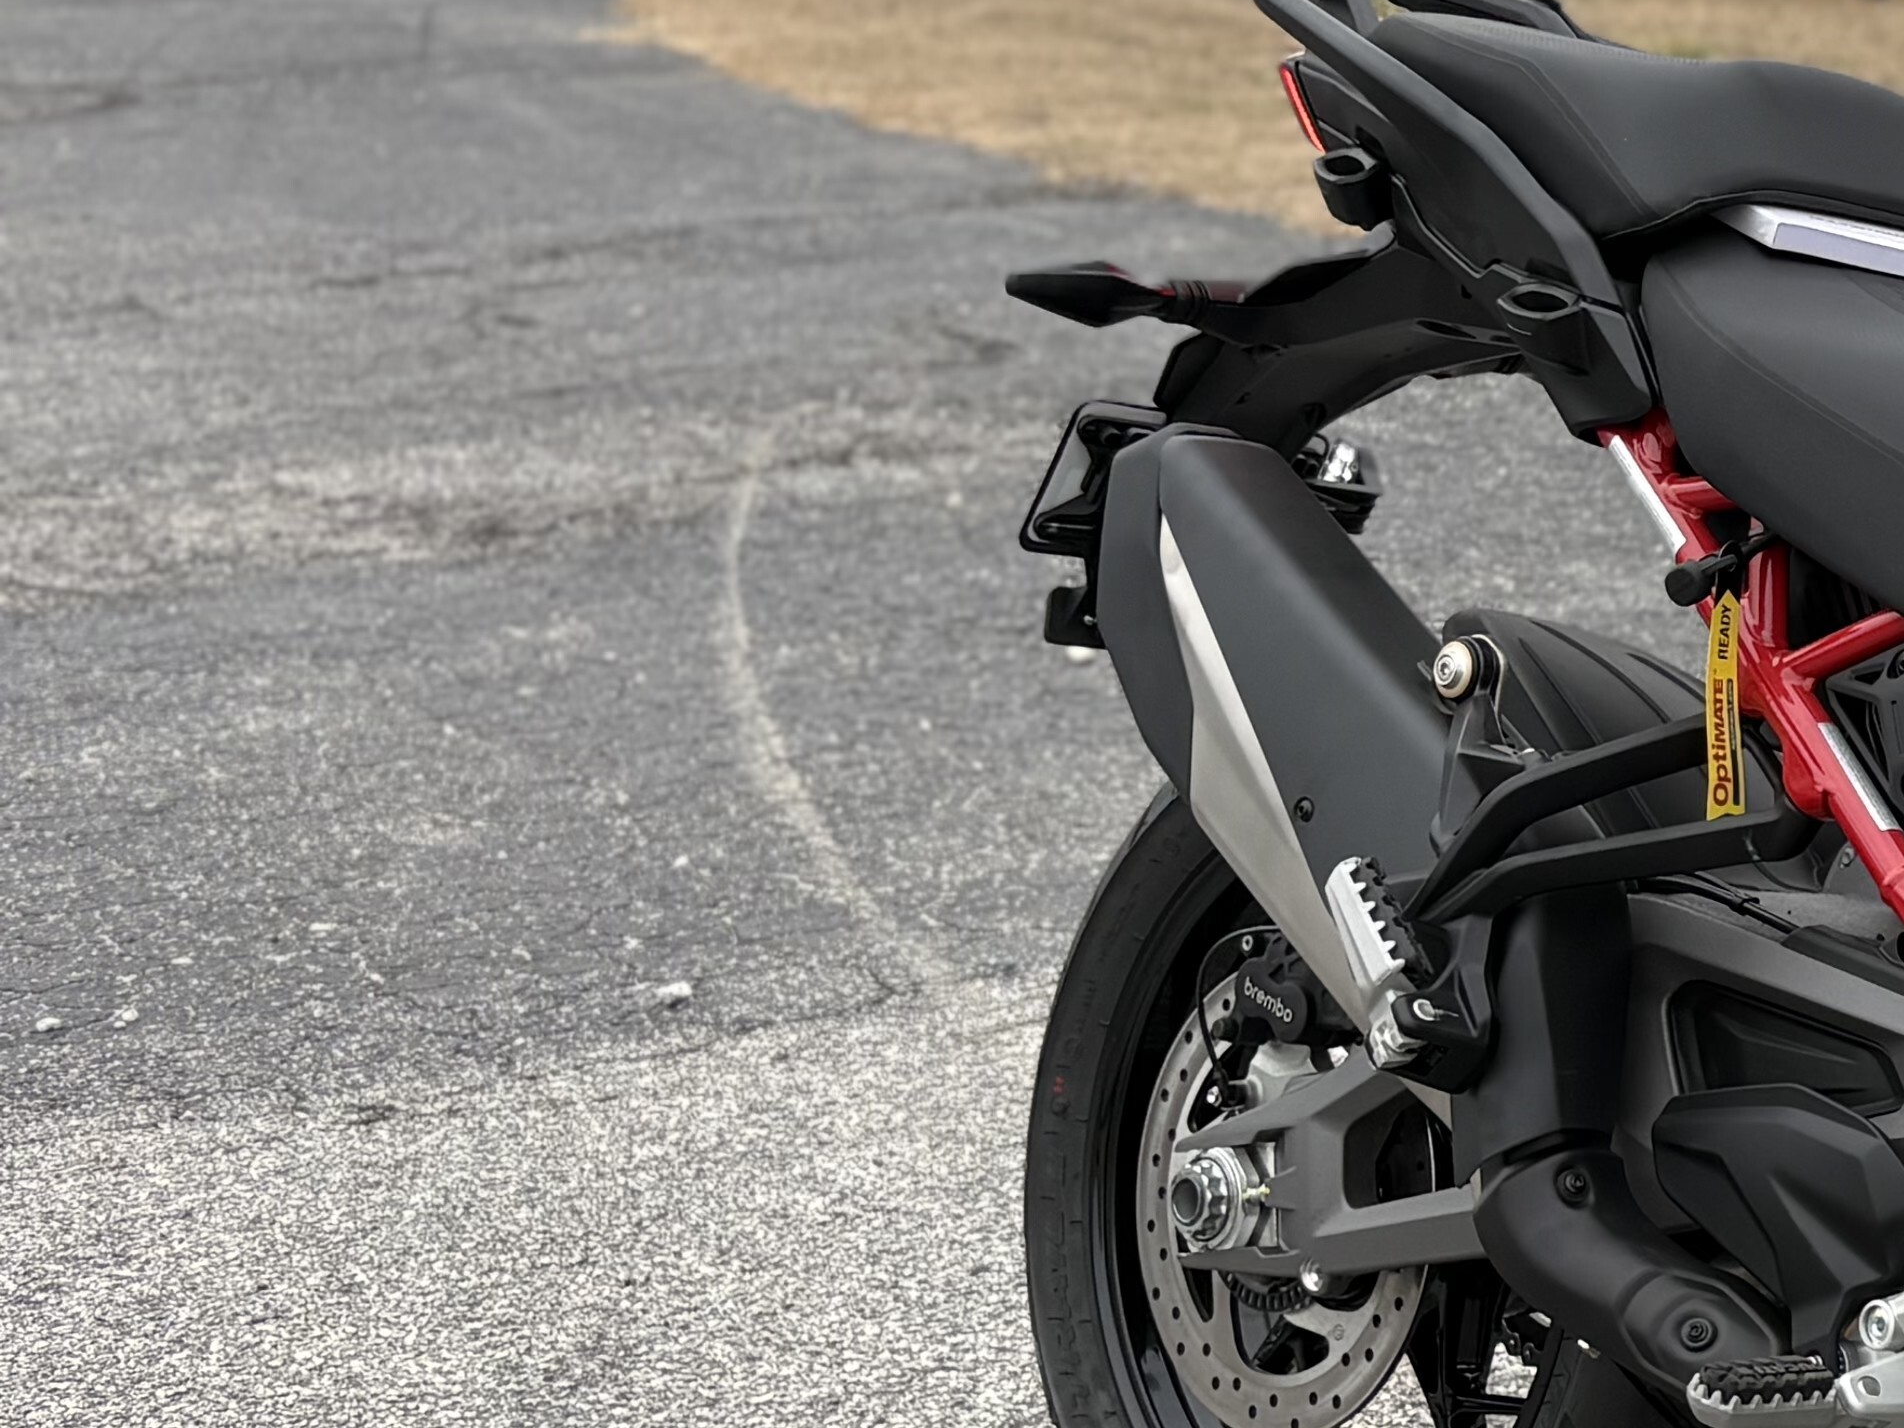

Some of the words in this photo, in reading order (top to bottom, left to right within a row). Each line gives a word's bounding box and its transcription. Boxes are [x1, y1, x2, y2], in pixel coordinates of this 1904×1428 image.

[1718, 604, 1731, 660] READY
[1712, 679, 1730, 806] OptiMATE
[1243, 975, 1294, 1023] brembo
